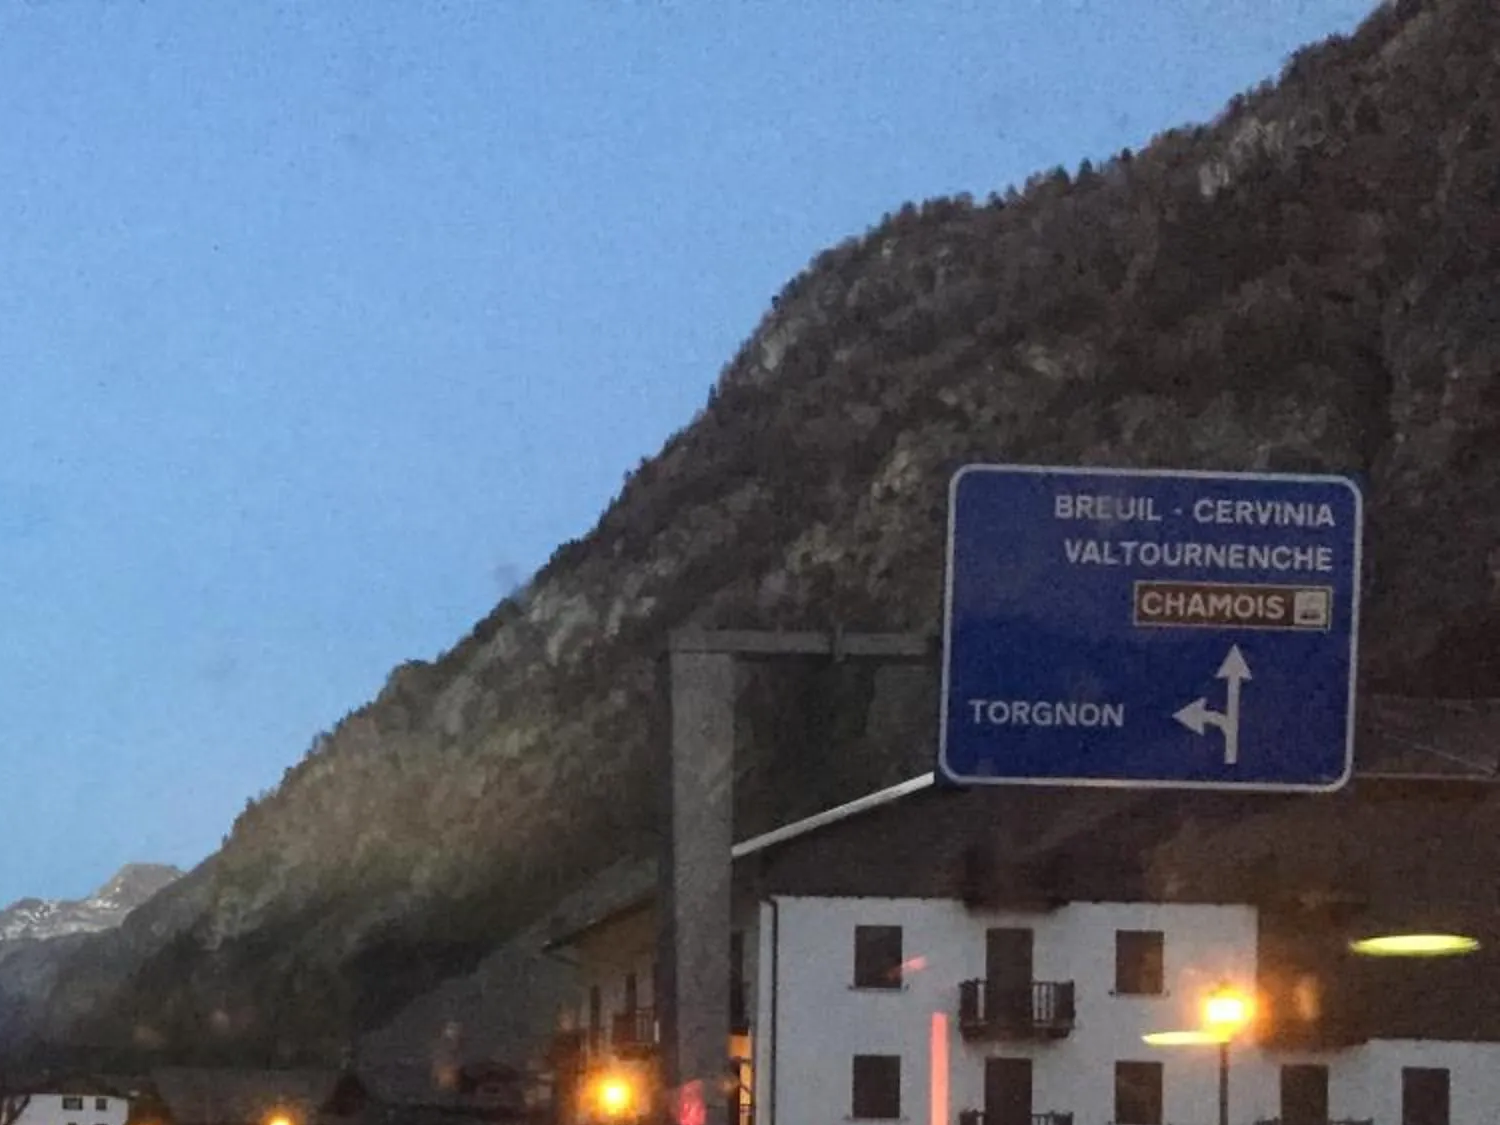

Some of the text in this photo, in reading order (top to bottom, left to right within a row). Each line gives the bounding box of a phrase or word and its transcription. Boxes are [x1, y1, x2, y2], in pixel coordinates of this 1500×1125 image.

[1054, 495, 1162, 521] BREUIL
[1193, 498, 1336, 528] CERVINIA
[1064, 538, 1333, 571] VALTOURNENCHE
[1140, 591, 1285, 619] CHAMOIS
[968, 699, 1124, 727] TORGNON
